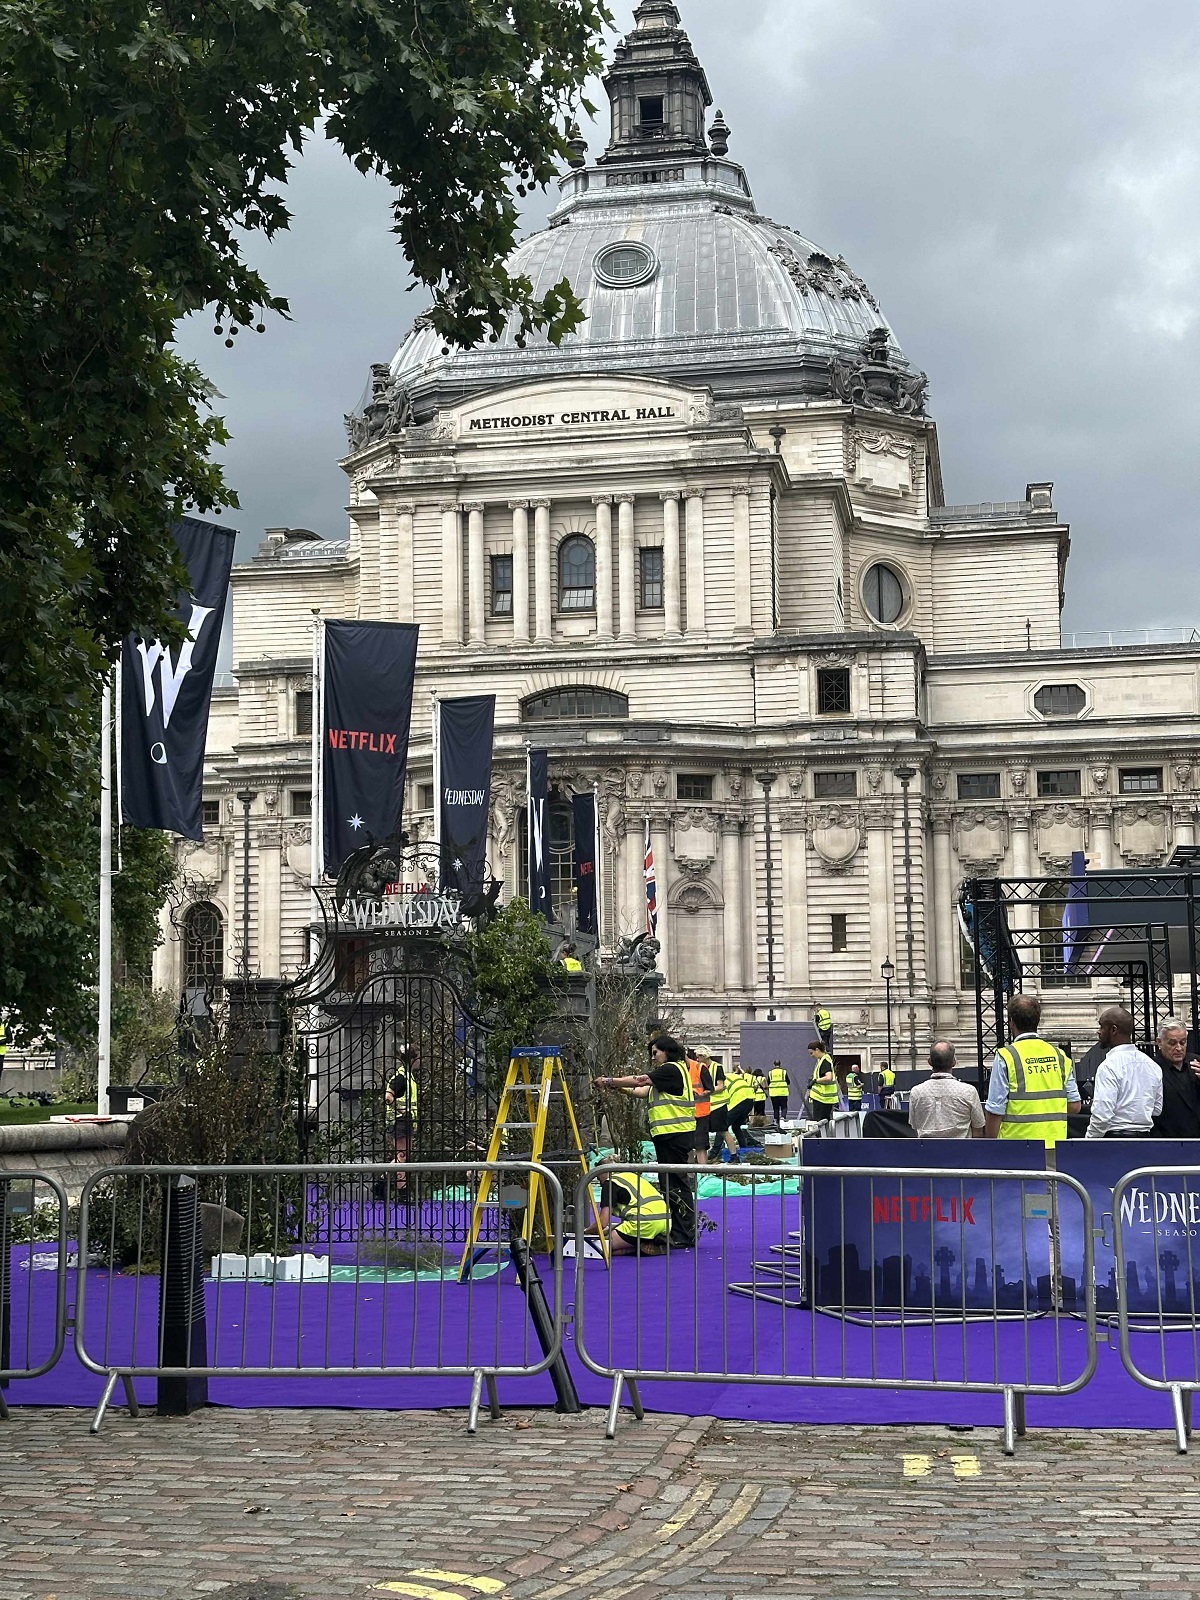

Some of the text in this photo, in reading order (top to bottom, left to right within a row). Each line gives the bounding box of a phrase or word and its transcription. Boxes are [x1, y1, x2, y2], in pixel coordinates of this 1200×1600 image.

[469, 406, 675, 430] METHODIST CENTRAL HALL
[136, 603, 216, 729] W
[328, 728, 398, 755] NETFLIX
[383, 882, 428, 896] NETFLIX
[350, 897, 462, 930] WEDNESDAY
[384, 929, 430, 937] SEASON 2
[1027, 1063, 1059, 1075] STAFF
[873, 1195, 976, 1226] NETFLIX
[1109, 1187, 1200, 1228] WEDNE
[1157, 1229, 1198, 1237] SEASO
